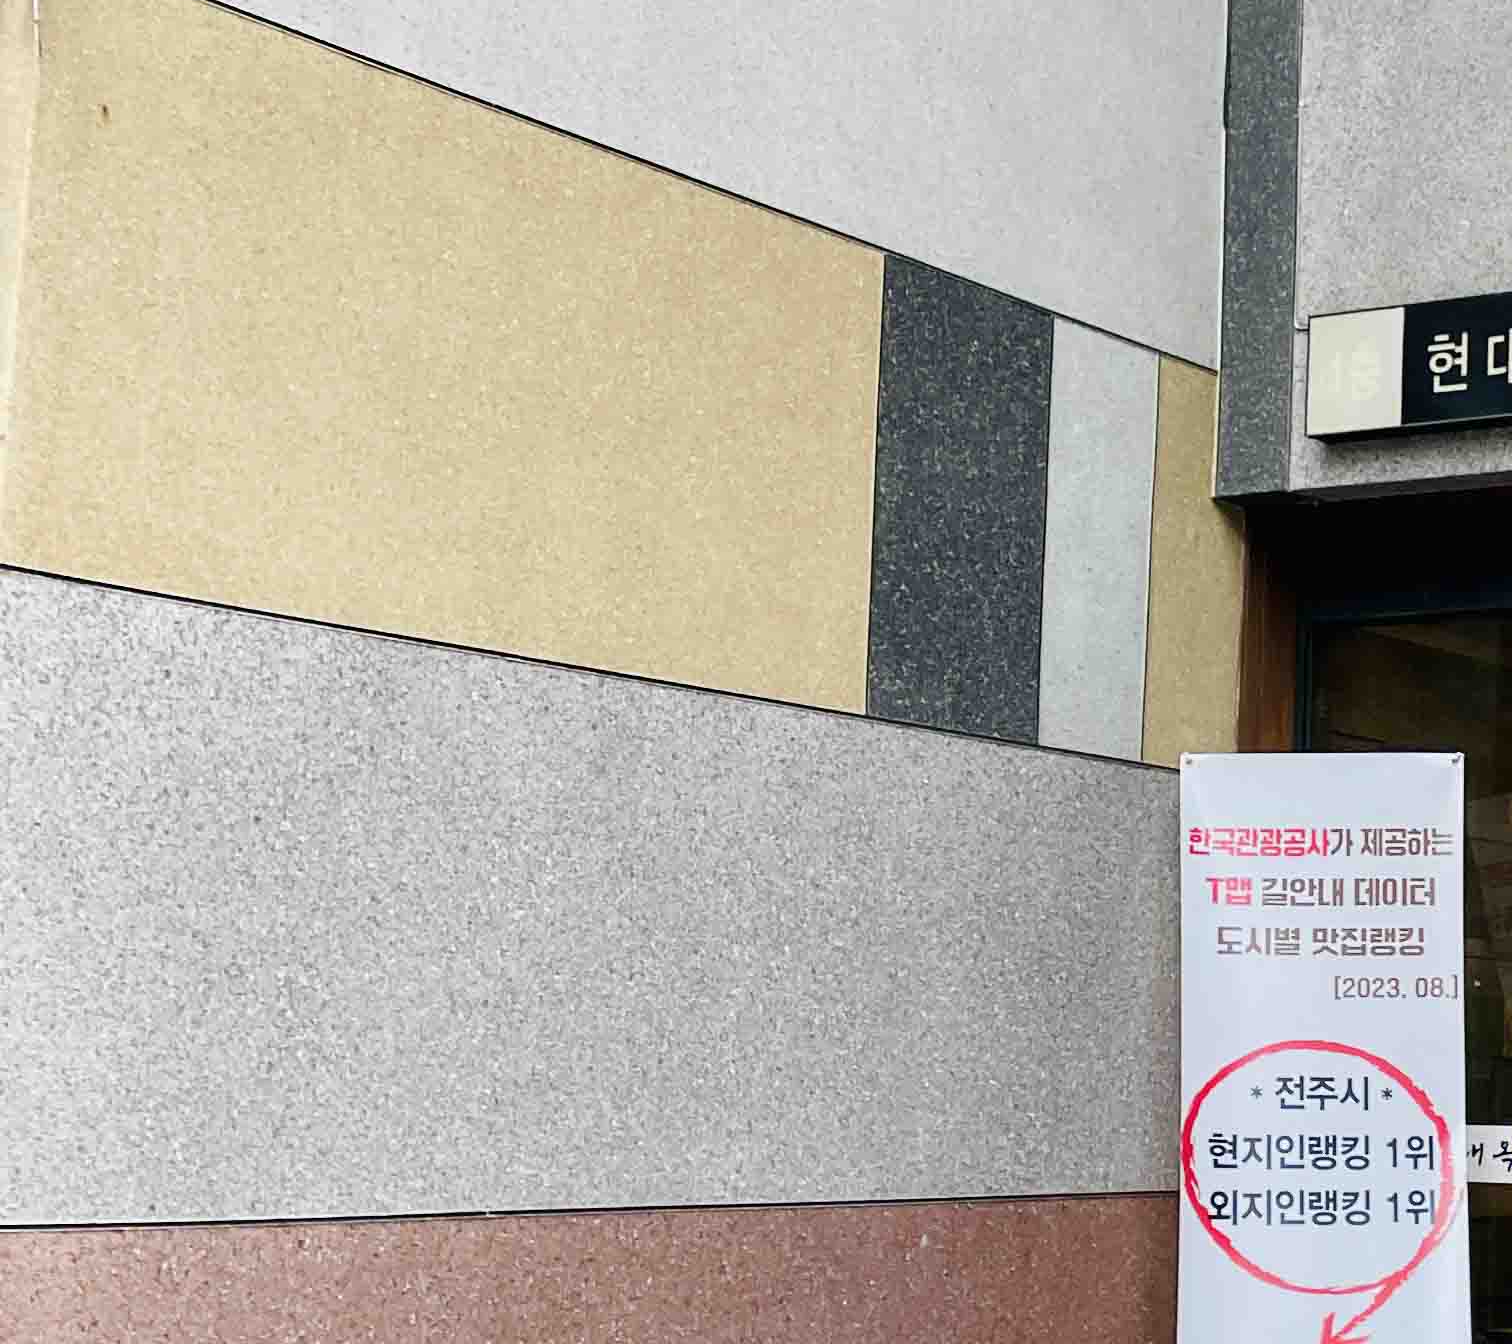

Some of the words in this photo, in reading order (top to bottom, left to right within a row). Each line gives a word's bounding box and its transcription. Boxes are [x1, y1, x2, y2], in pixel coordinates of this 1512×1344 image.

[1187, 826, 1353, 858] 한국관광공사가
[1359, 826, 1455, 857] 제공하는
[1204, 876, 1254, 906] T맵
[1261, 876, 1345, 906] 길안내
[1353, 876, 1437, 906] 데이터
[1216, 925, 1302, 957] 도시별
[1311, 925, 1426, 957] 맛집랭킹
[1274, 1074, 1370, 1112] 전주시
[1207, 1132, 1371, 1171] 현지인랭킹
[1385, 1134, 1436, 1171] 1위
[1207, 1189, 1372, 1227] 외지인랭킹
[1385, 1189, 1437, 1226] 1위
